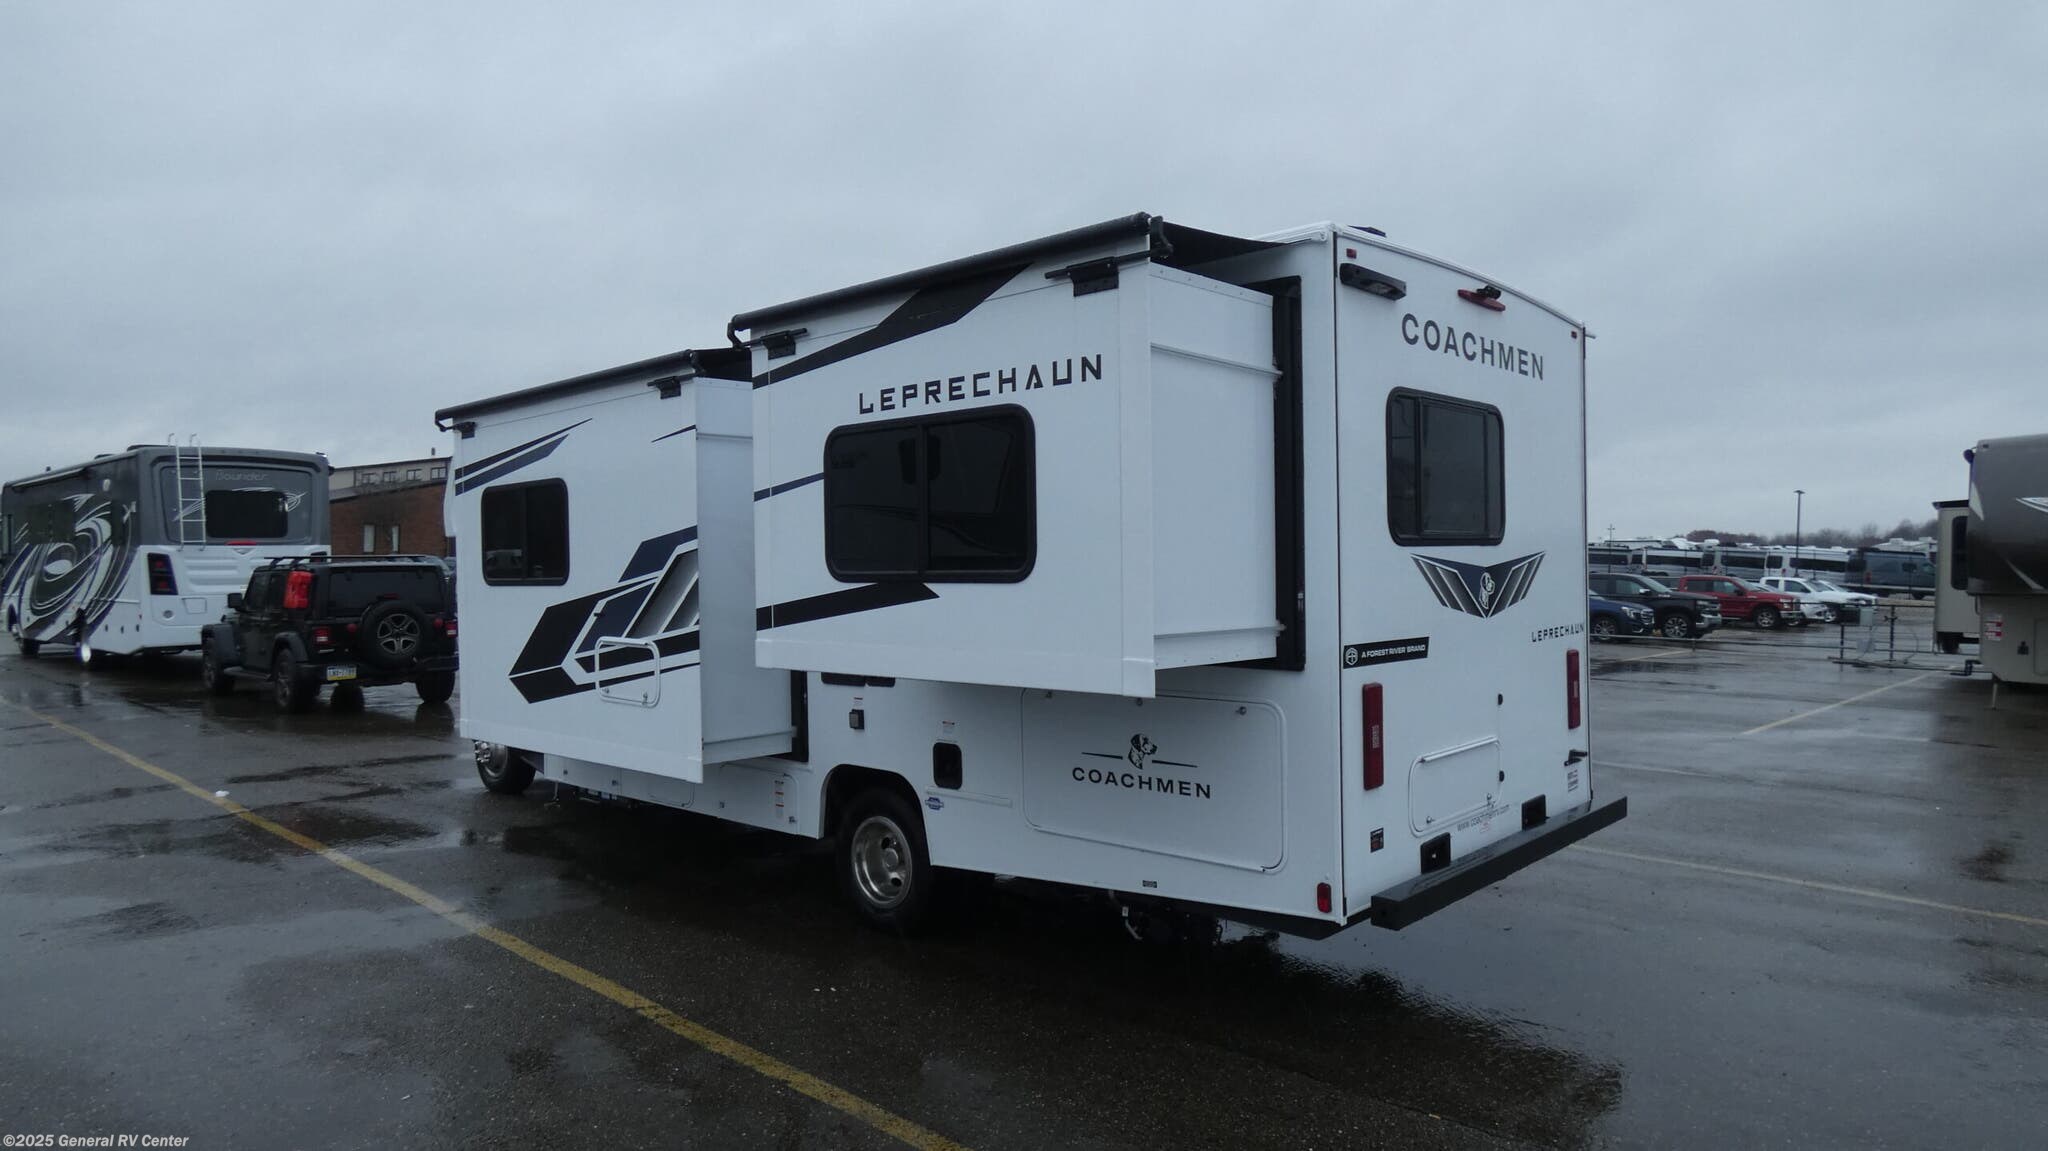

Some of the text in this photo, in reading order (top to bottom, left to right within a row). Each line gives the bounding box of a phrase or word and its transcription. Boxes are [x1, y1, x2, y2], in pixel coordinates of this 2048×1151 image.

[1401, 312, 1544, 381] COACHMEN
[859, 354, 1102, 415] LEPRECHAUN
[1531, 623, 1584, 643] LEPRECHAUN
[1367, 649, 1389, 658] FOREST
[1389, 646, 1406, 655] RIVER
[1406, 644, 1426, 653] BRAND
[1072, 766, 1211, 799] COACHMEN
